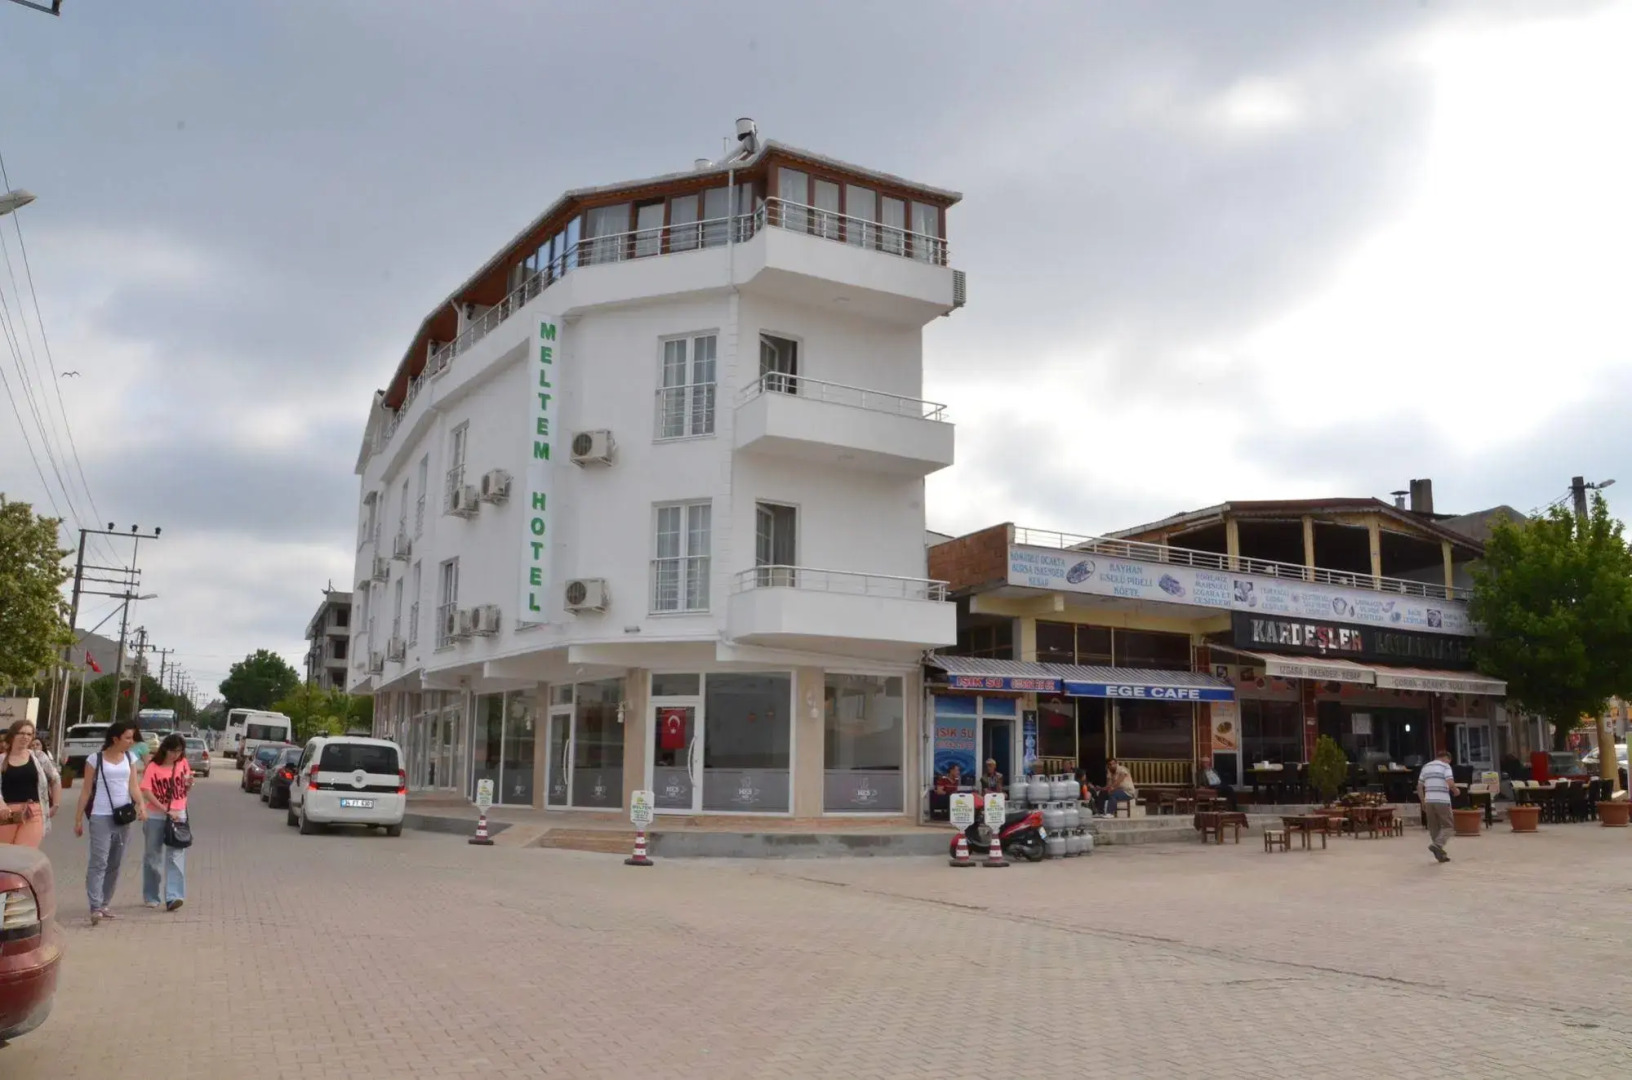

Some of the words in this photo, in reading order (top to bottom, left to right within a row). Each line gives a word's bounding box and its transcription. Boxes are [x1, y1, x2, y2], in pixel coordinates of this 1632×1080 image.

[533, 322, 557, 461] MELTEM
[528, 491, 547, 613] HOTEL
[1105, 685, 1146, 697] EGE
[1150, 687, 1201, 699] CAFE
